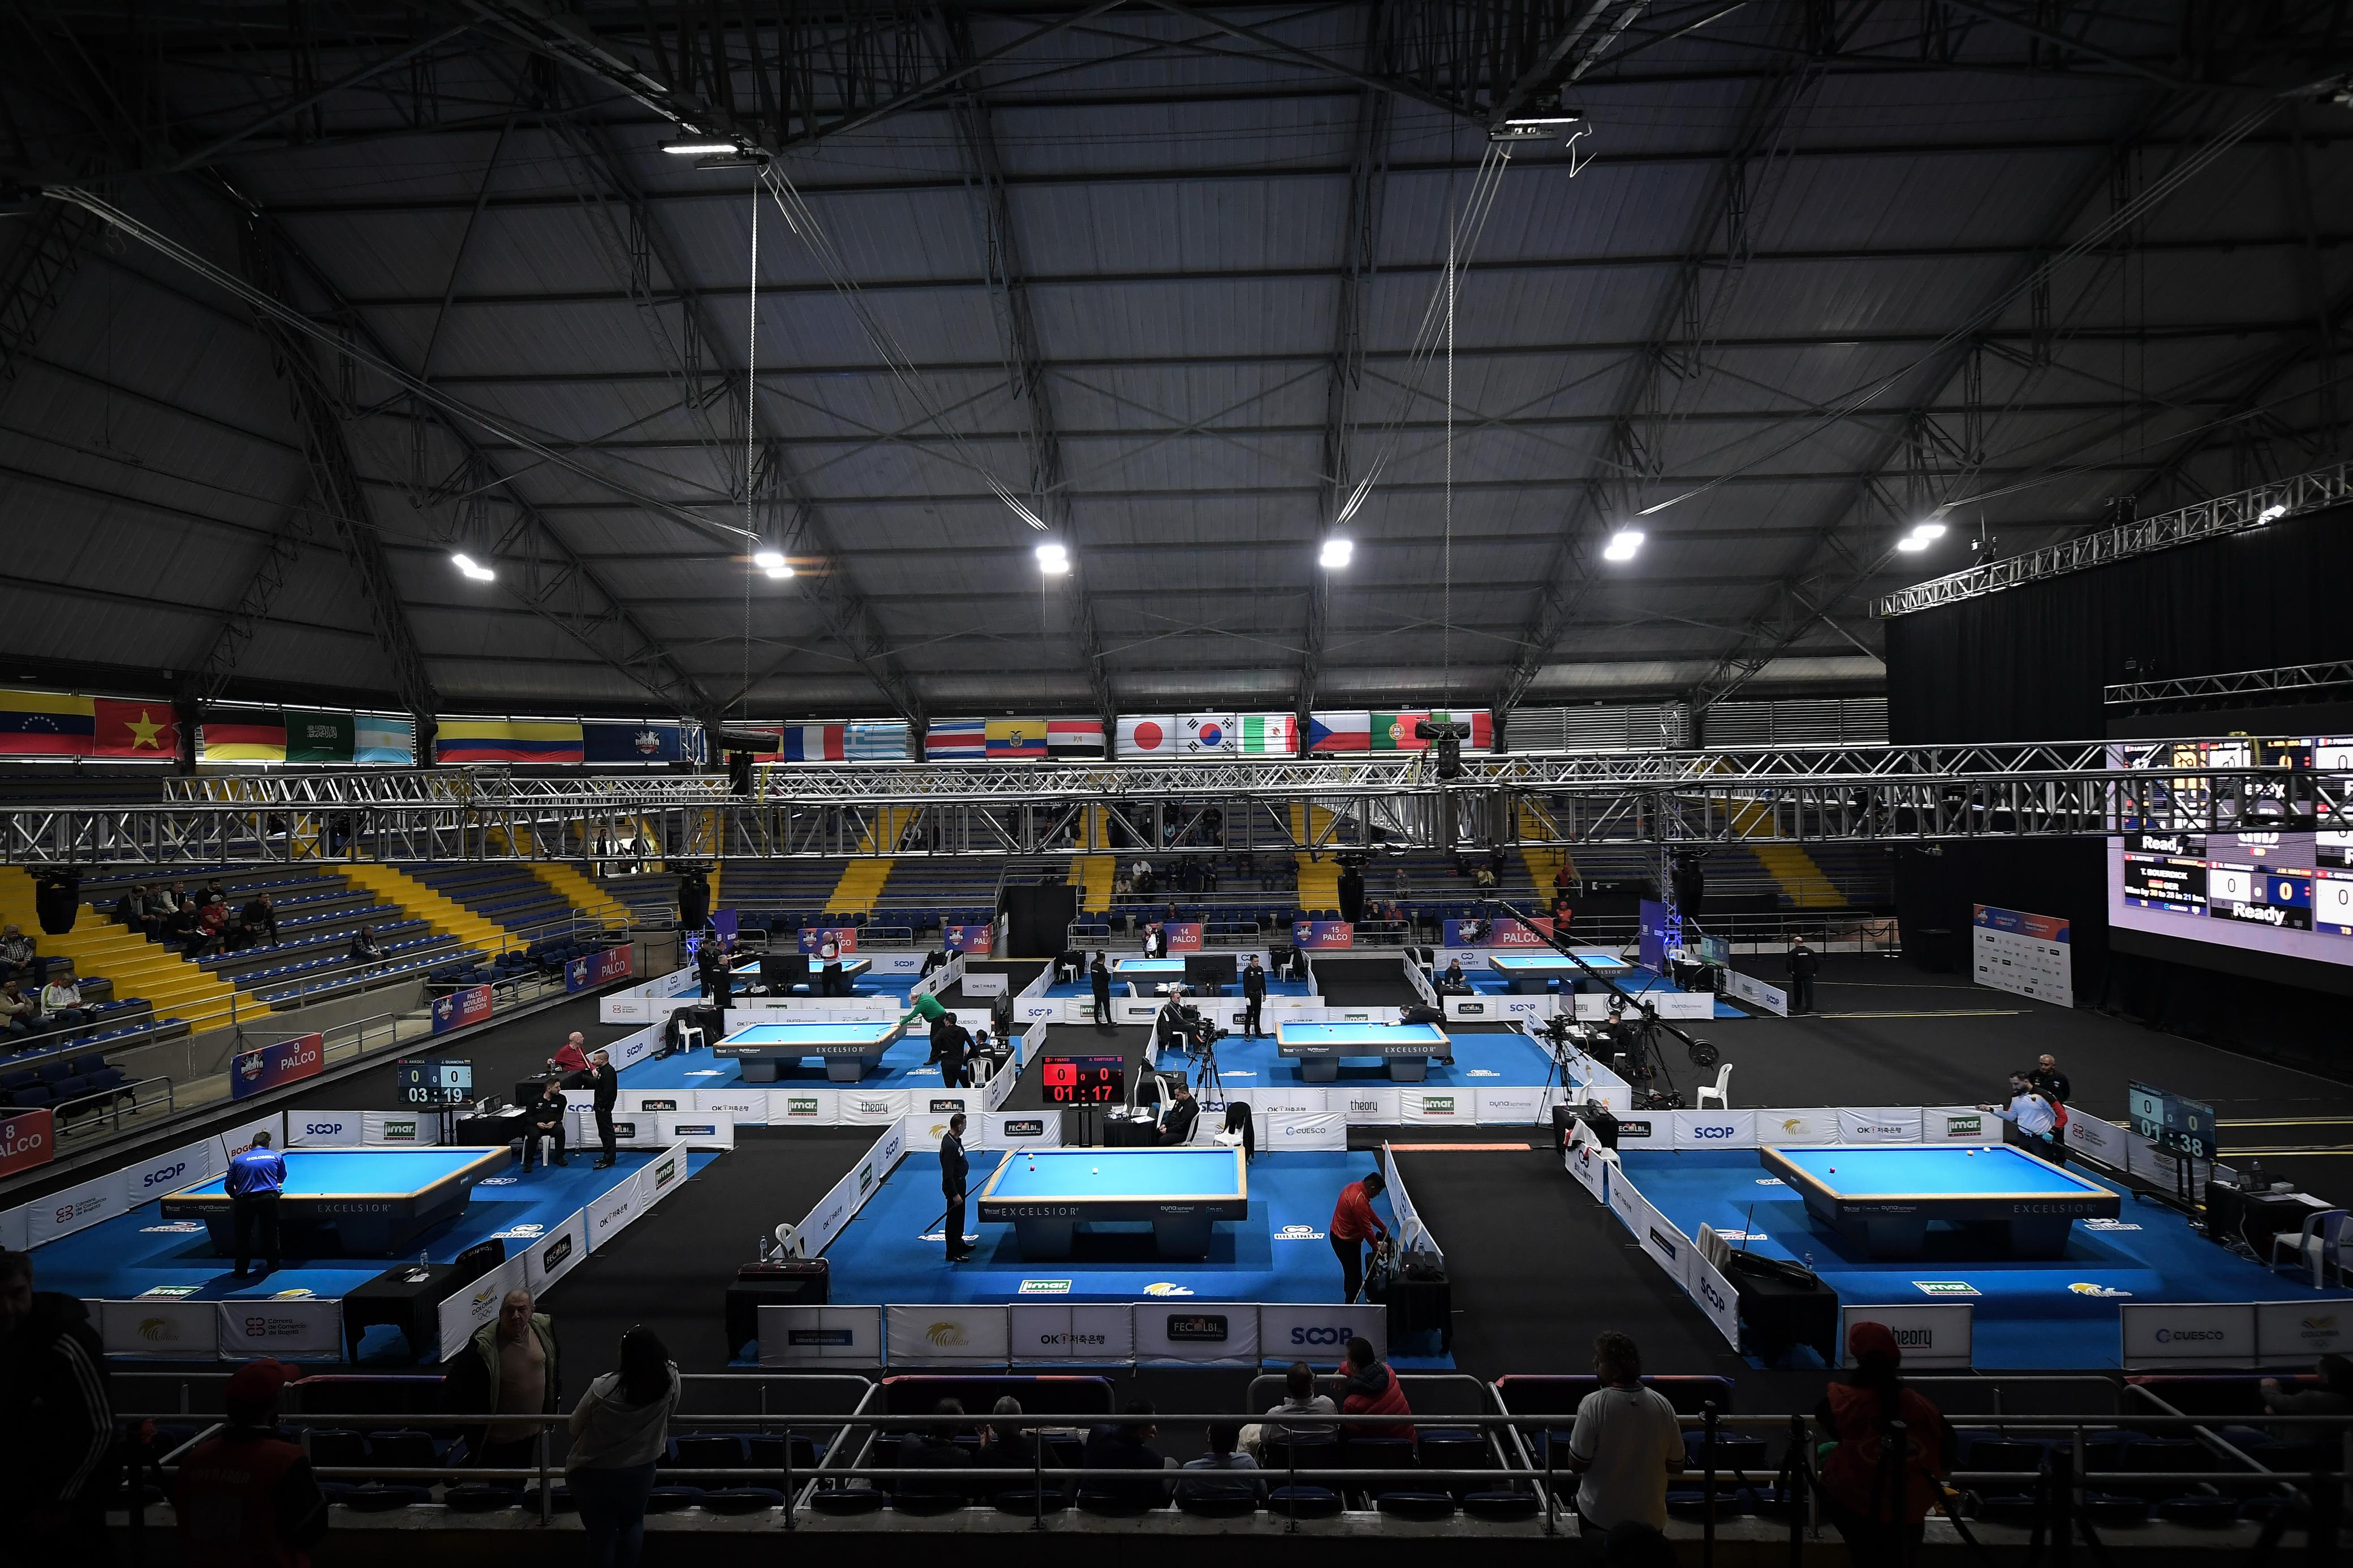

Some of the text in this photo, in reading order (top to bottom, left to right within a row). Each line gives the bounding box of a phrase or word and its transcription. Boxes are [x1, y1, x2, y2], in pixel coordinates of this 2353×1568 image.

[2141, 888, 2149, 896] by
[2227, 878, 2292, 900] 0 0 0
[2338, 889, 2348, 905] 0
[2233, 901, 2285, 926] Ready
[1503, 933, 1540, 943] PALCO
[609, 951, 617, 961] 11
[602, 961, 625, 977] PALCO
[463, 996, 487, 1008] MOVILIDAD
[467, 991, 482, 1000] PALCO
[1766, 994, 1779, 1005] SOOP
[464, 1003, 487, 1014] REDUCIDA
[294, 1042, 300, 1053] 9
[627, 1043, 643, 1057] SOOP
[281, 1050, 316, 1070] PALCO
[411, 1070, 419, 1082] 0
[450, 1070, 459, 1083] 0
[1057, 1069, 1066, 1081] 0
[1100, 1068, 1109, 1081] 0
[861, 1102, 887, 1113] theory
[1350, 1100, 1377, 1112] theory
[2144, 1099, 2198, 1131] 0 0 0
[6, 1125, 15, 1139] 8
[306, 1124, 342, 1135] SOOP
[1694, 1126, 1734, 1138] SOOP
[0, 1134, 42, 1157] ALCO
[231, 1143, 254, 1157] BOGO
[885, 1137, 899, 1159] SOOP
[144, 1163, 186, 1187] SOOP
[318, 1204, 388, 1212] EXCELSIOR
[1002, 1207, 1076, 1216] EXCELSIOR
[2014, 1204, 2094, 1212] EXCELSIOR
[1701, 1276, 1725, 1314] SOOP
[472, 1295, 498, 1316] COLOMBIA
[1291, 1327, 1353, 1345] SOOP
[1892, 1326, 1932, 1349] heory
[2174, 1331, 2224, 1340] CUESCO
